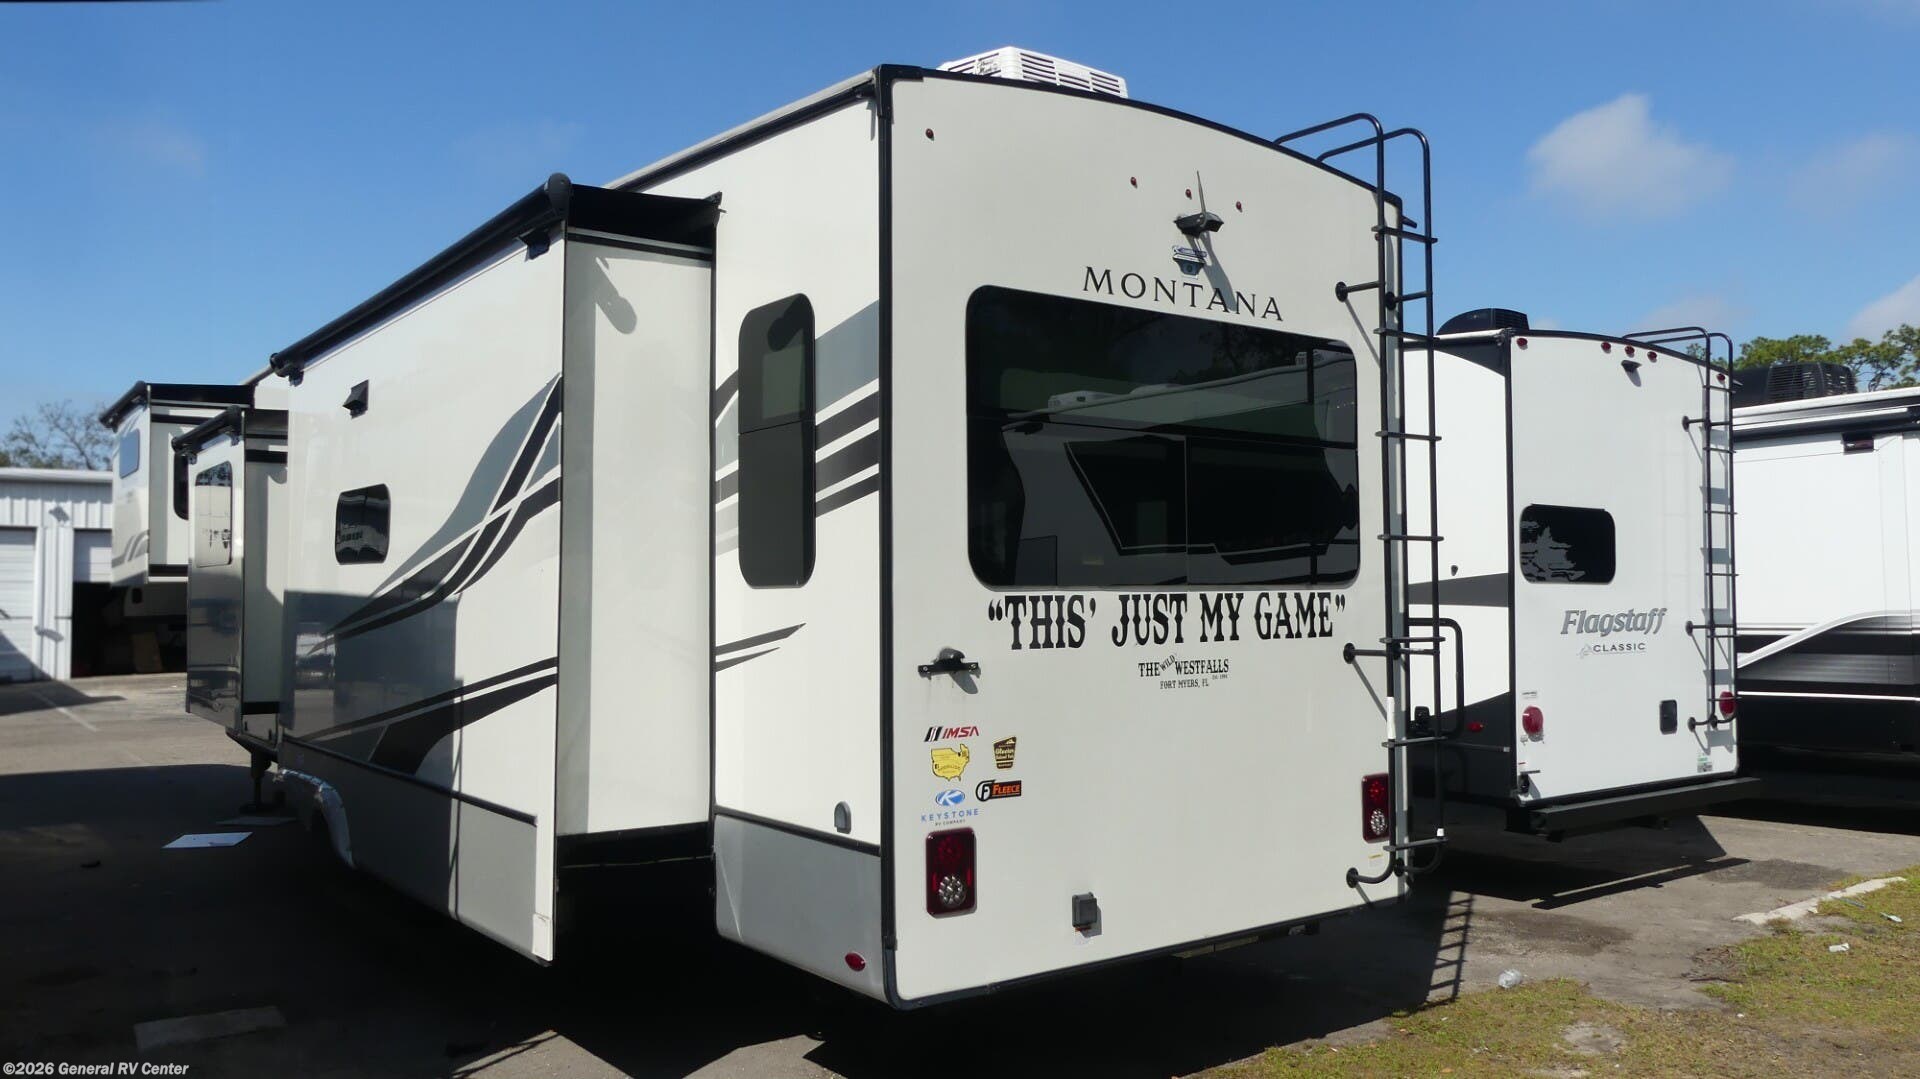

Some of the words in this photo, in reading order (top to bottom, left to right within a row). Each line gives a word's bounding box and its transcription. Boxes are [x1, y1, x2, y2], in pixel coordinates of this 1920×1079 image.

[1083, 266, 1284, 321] MONTANA
[1112, 593, 1188, 647] JUST
[1199, 592, 1244, 643] MY
[1560, 608, 1668, 637] Flagstaff
[1592, 642, 1646, 653] CLASSIC
[1138, 661, 1160, 677] THE
[1160, 654, 1176, 671] WILD
[1175, 658, 1229, 676] WESTFALLS
[1160, 679, 1176, 689] FORT
[942, 726, 979, 739] IMSA
[921, 808, 979, 822] KEYSTONE
